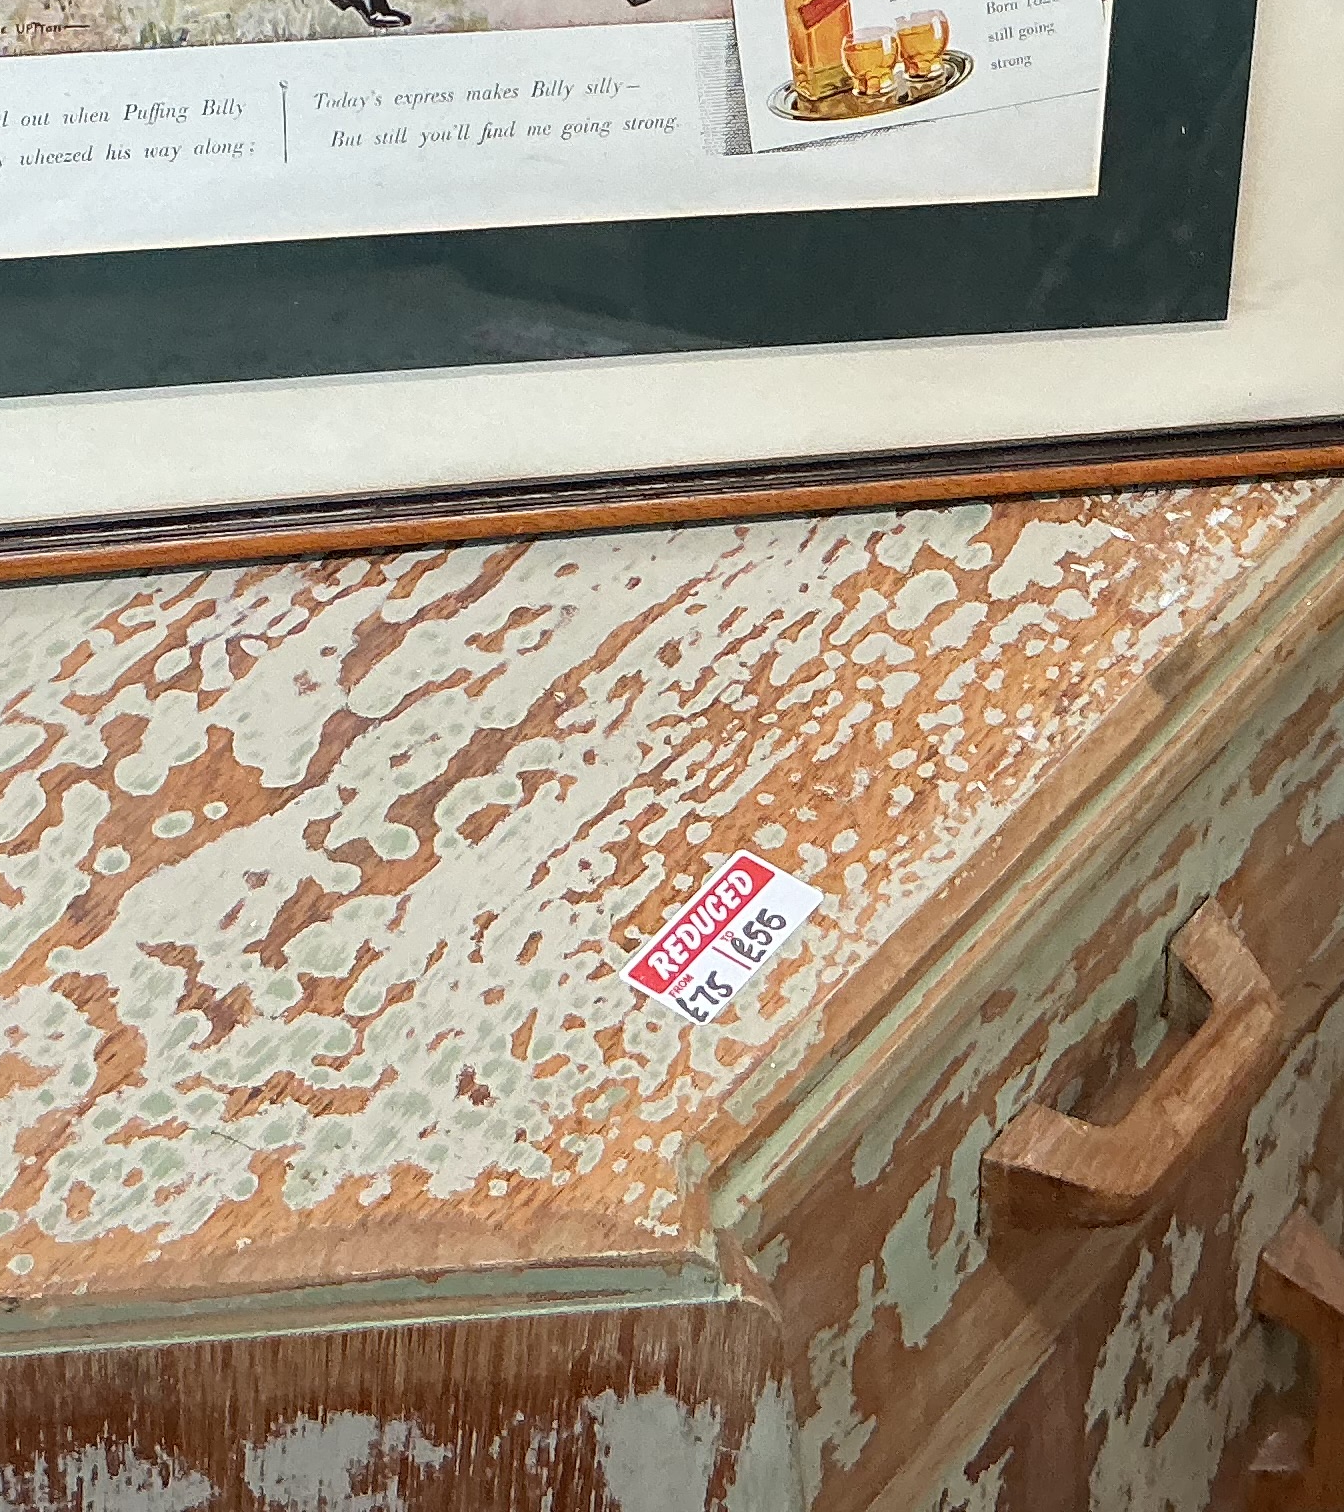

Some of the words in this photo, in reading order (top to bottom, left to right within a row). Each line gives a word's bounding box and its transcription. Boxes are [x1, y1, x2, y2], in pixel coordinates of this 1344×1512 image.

[986, 0, 1019, 16] Born
[987, 26, 1015, 44] still
[1017, 19, 1056, 42] going
[989, 52, 1033, 71] strong
[313, 90, 383, 111] Today's
[393, 90, 455, 111] express
[465, 82, 521, 102] makes
[530, 79, 576, 101] Billy
[20, 112, 51, 127] out
[62, 105, 111, 126] when
[123, 100, 190, 126] Puffing
[201, 97, 247, 120] Billy
[330, 130, 363, 148] But
[373, 126, 408, 146] still
[417, 123, 471, 148] you'll
[476, 120, 516, 146] find
[526, 123, 552, 137] me
[560, 117, 613, 140] going
[18, 146, 94, 167] wheezed
[105, 142, 132, 162] his
[143, 143, 183, 164] way
[647, 869, 754, 981] REDUCED
[667, 973, 695, 999] FROM
[719, 930, 736, 943] TO
[674, 969, 734, 1023] £75
